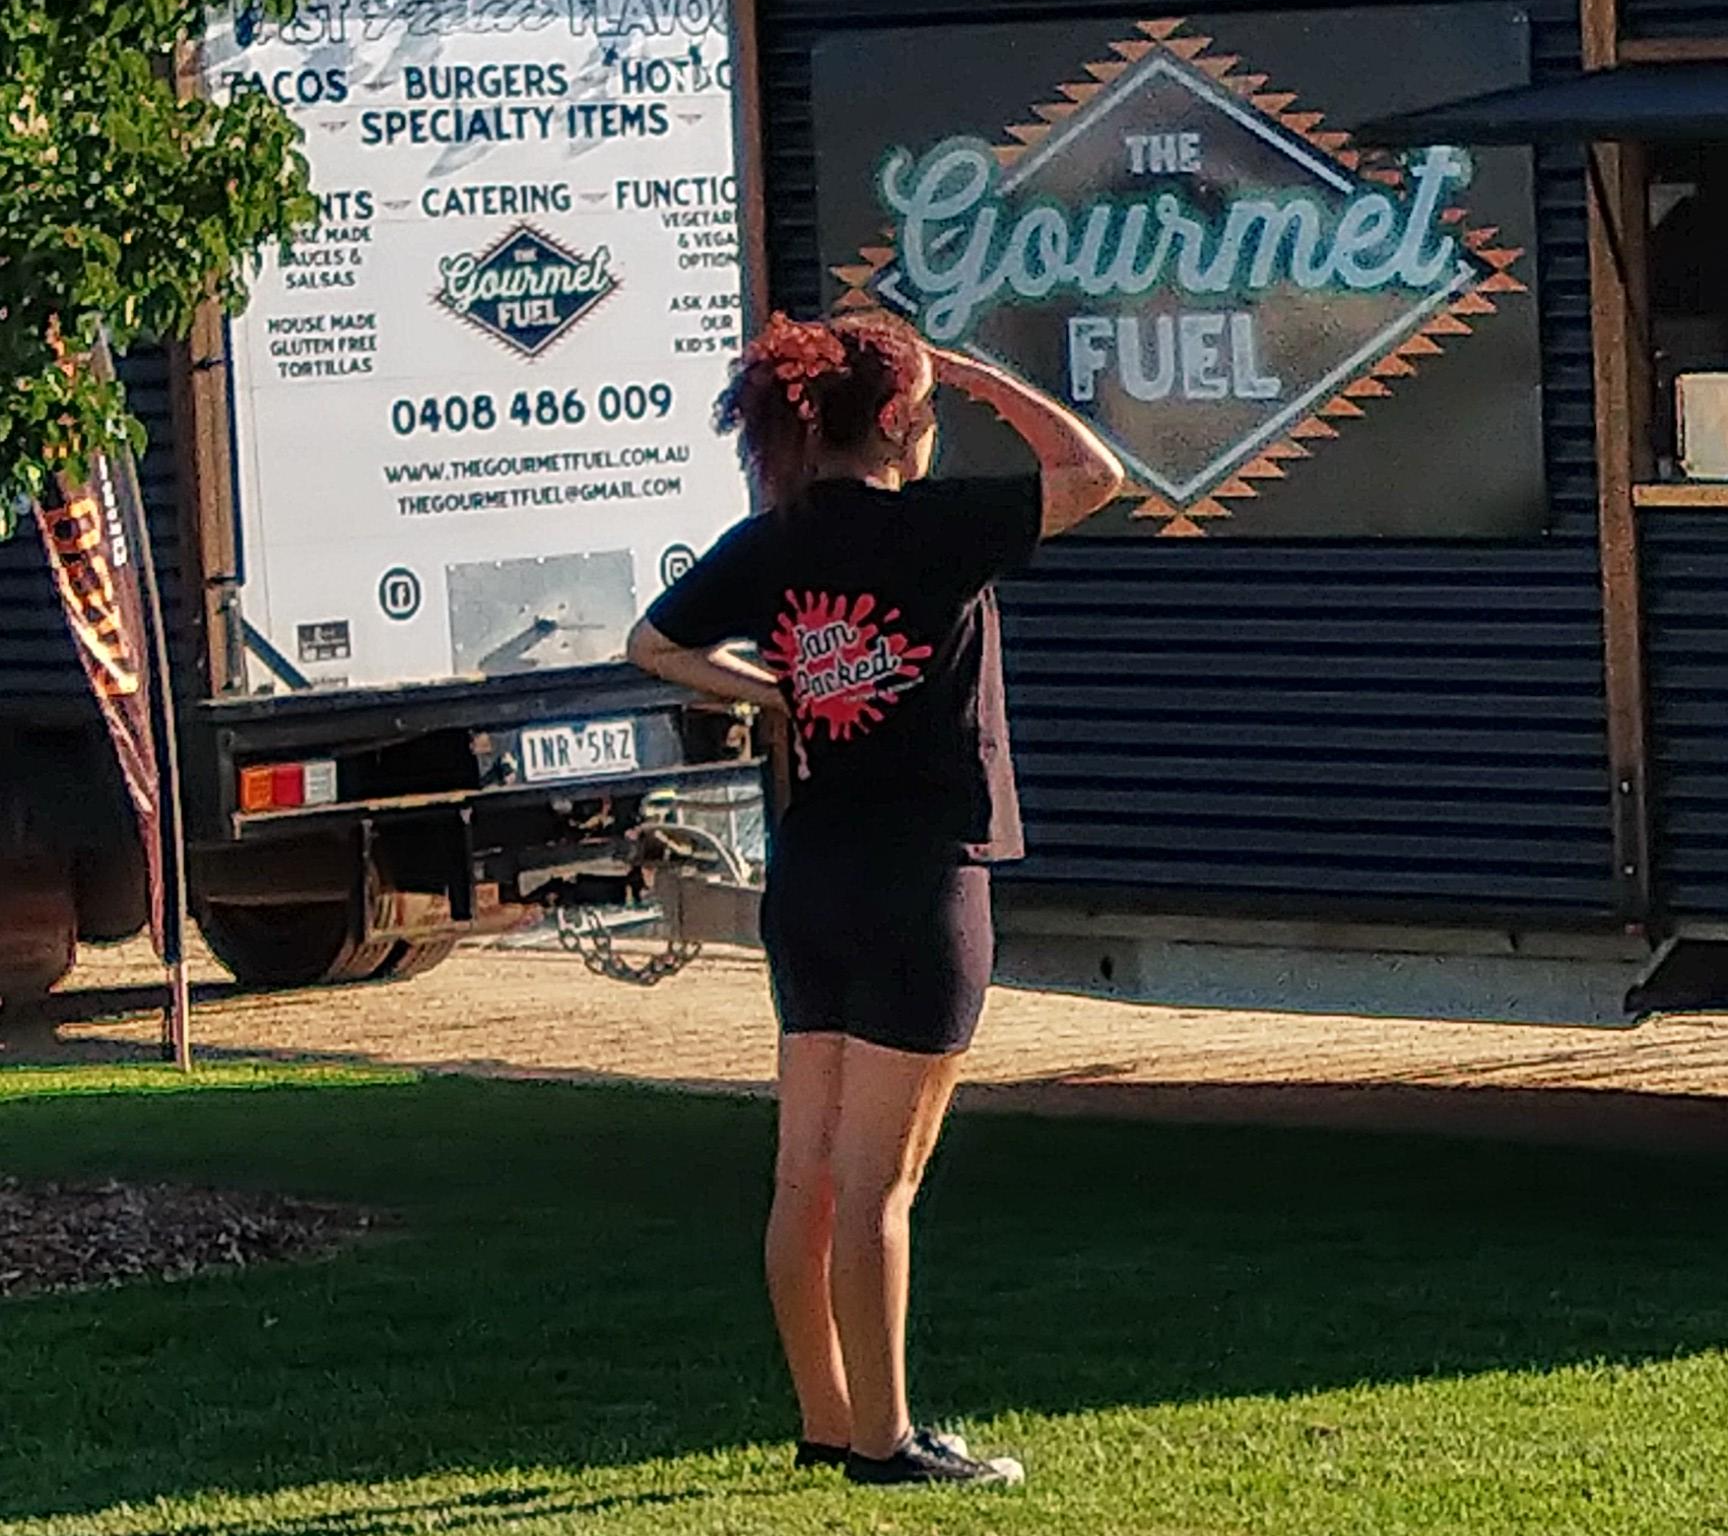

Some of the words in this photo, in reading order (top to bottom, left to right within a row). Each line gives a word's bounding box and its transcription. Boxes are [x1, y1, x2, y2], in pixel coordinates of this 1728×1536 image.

[404, 64, 569, 101] BURGERS
[361, 106, 554, 144] SPECIALTY
[567, 102, 669, 139] ITEMS
[1125, 132, 1201, 175] THE
[421, 183, 572, 217] CATERING
[326, 226, 372, 242] MADE
[881, 137, 1474, 346] Gourmet
[285, 271, 355, 289] SALSAS
[440, 246, 610, 312] Gourmet
[497, 297, 562, 328] FUEL
[669, 295, 702, 311] ASK
[268, 316, 326, 334] HOUSE
[331, 314, 376, 331] MADE
[701, 315, 733, 331] OUR
[270, 337, 333, 356] GLUTEN
[338, 335, 377, 352] FREE
[1067, 312, 1282, 404] FUEL
[278, 358, 372, 378] TORTILLAS
[392, 395, 496, 435] 0408
[510, 389, 585, 426] 486
[599, 383, 672, 421] 009
[384, 445, 690, 484] WWW.THEGOURMETFUEL.COM.AU
[398, 477, 682, 515] THEGOURMETFUEL@GMAIL.COM
